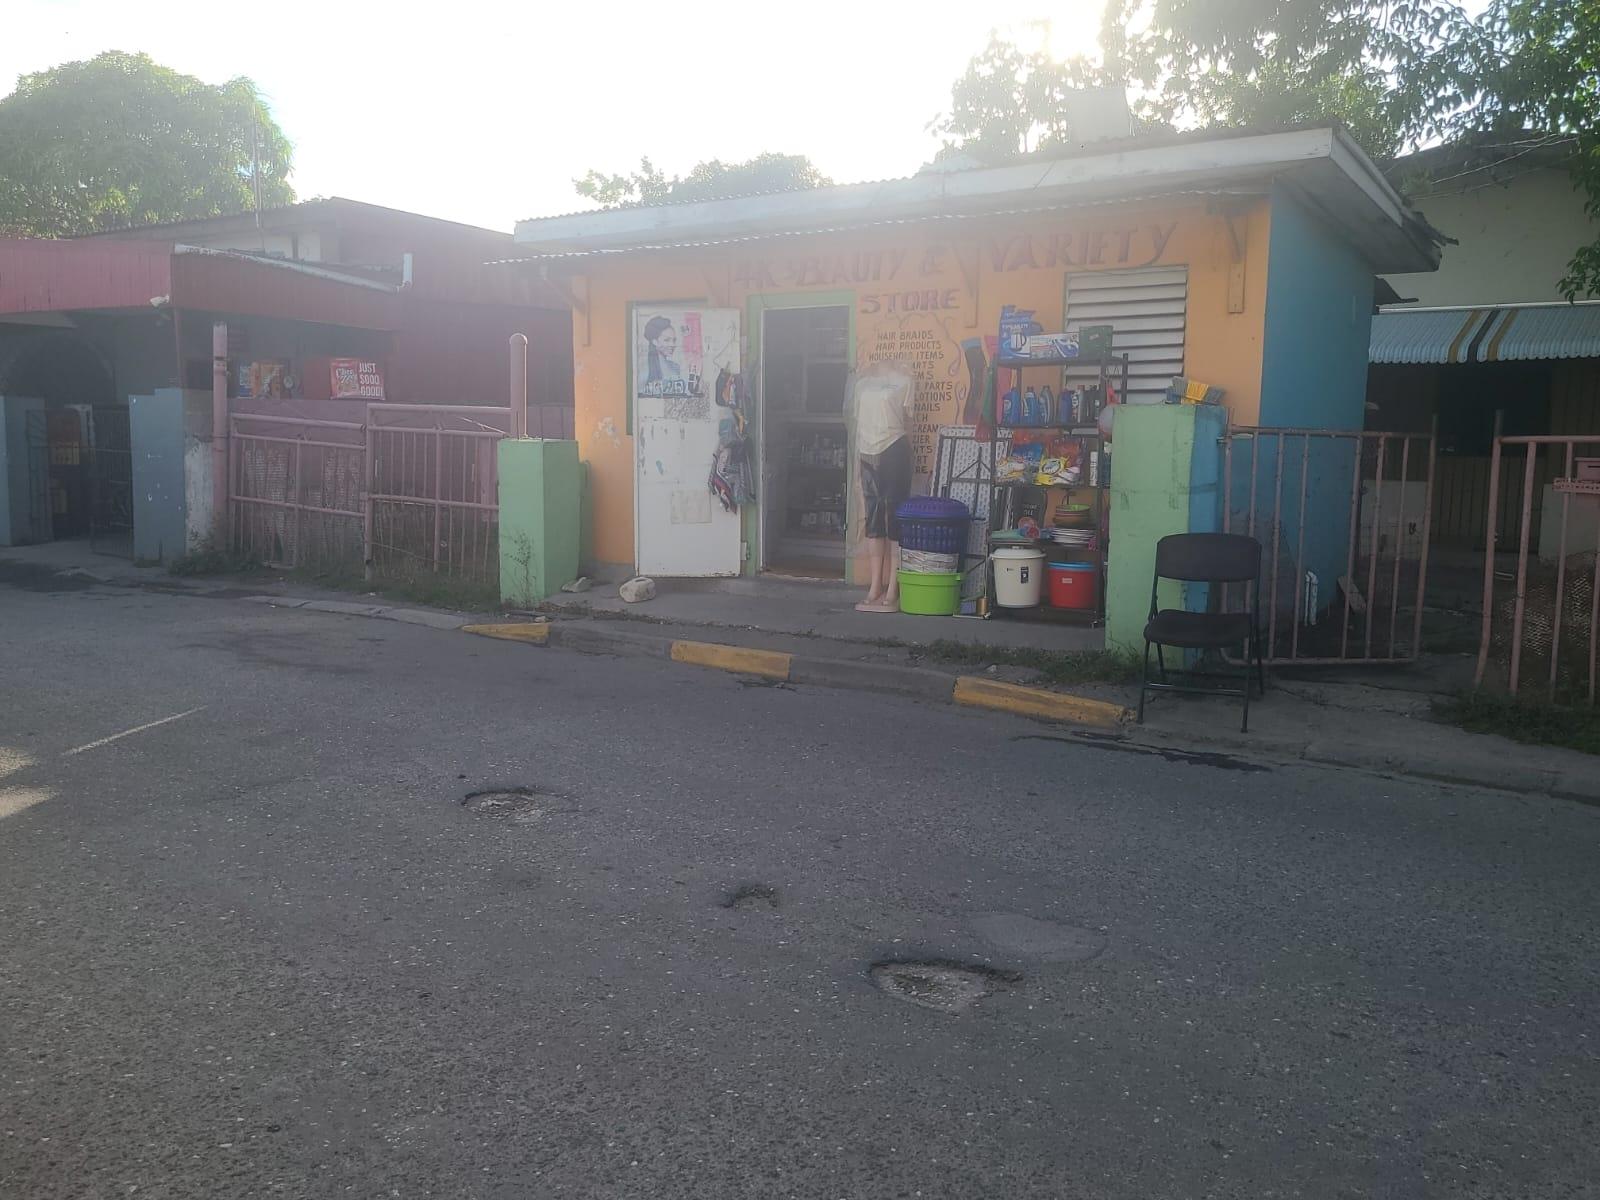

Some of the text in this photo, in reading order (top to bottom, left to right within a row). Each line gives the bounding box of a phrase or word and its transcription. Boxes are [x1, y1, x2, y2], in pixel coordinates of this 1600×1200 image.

[989, 221, 1179, 272] VARIETY
[860, 288, 961, 314] STORE
[876, 330, 934, 341] HAIR BRAIDS
[875, 340, 942, 352] HAIR PRODUCTS
[917, 350, 945, 361] ITEMS
[359, 362, 376, 373] JUST
[912, 361, 935, 370] ARTS
[925, 381, 953, 391] PARTS
[914, 391, 952, 402] LOTIONS
[914, 402, 941, 413] NAILS
